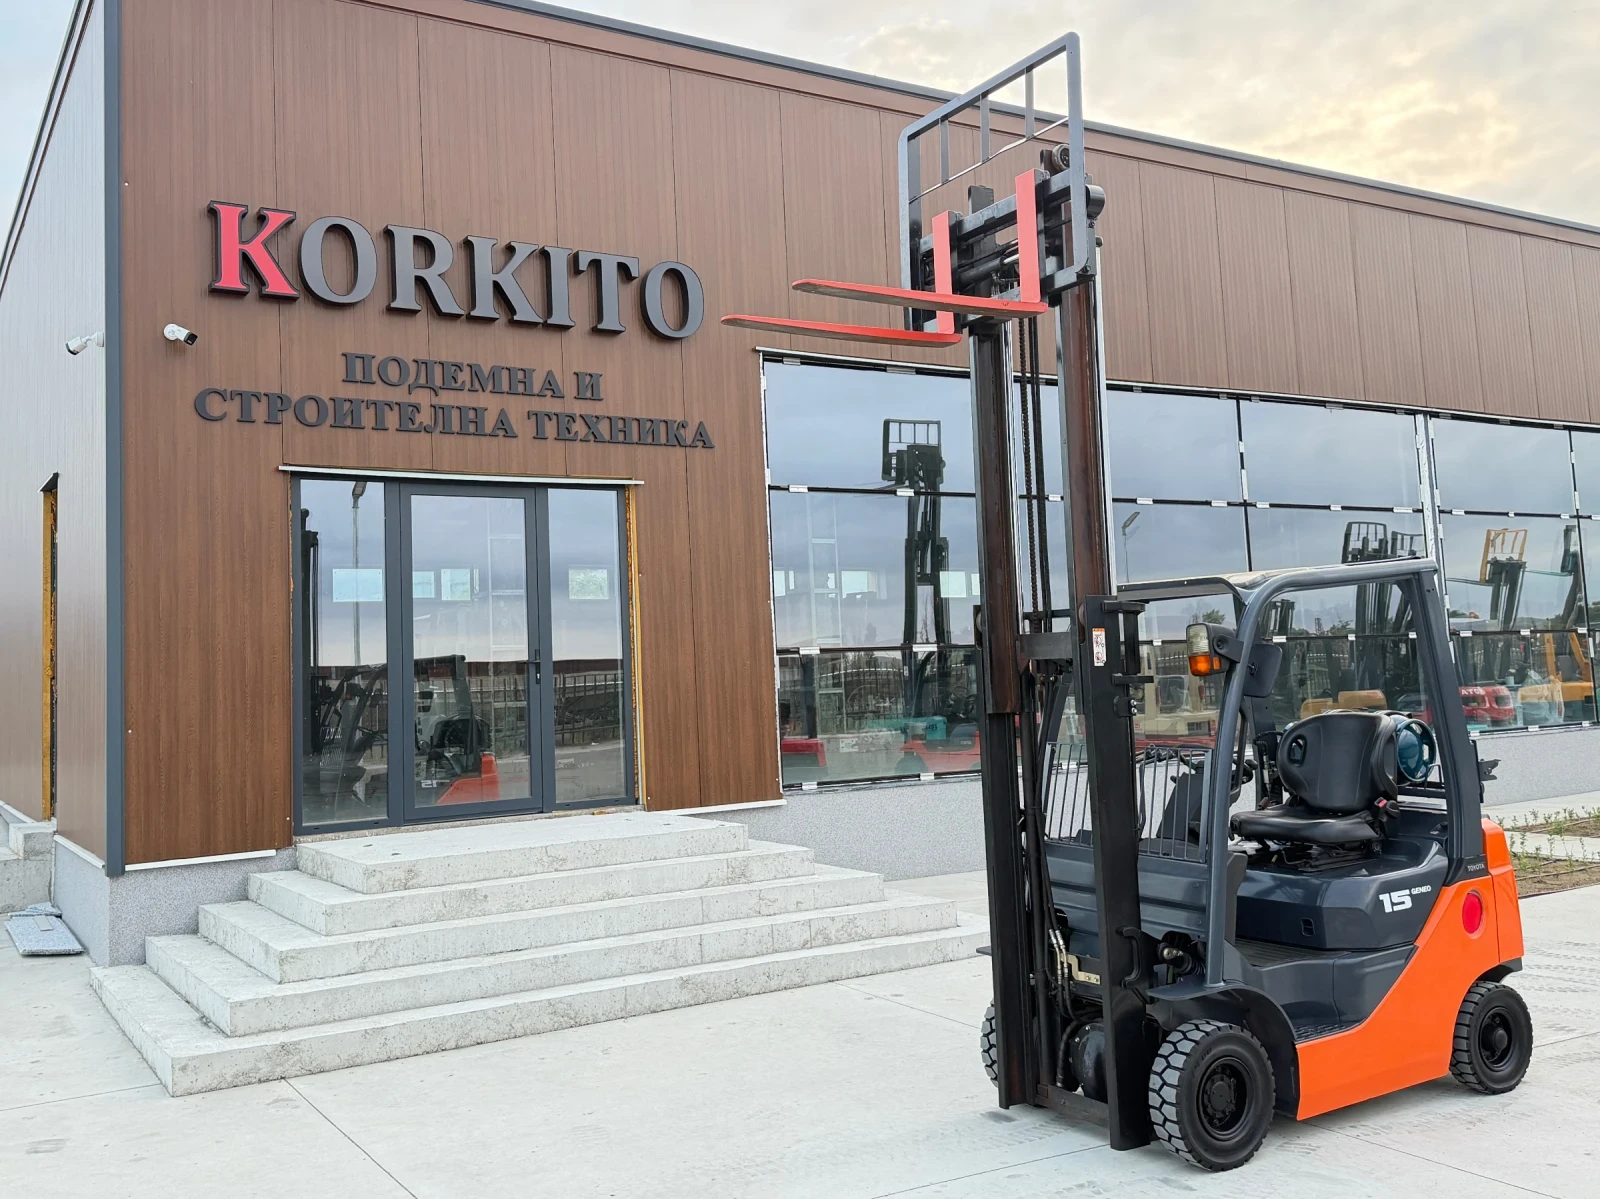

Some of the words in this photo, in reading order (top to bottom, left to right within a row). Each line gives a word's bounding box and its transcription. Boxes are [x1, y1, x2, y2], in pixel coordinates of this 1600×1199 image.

[206, 200, 704, 340] KORKITO
[342, 352, 565, 398] ПОДЕМНА
[574, 371, 603, 401] И
[194, 388, 517, 438] СТРОИТЕЛНА
[528, 410, 715, 449] ТЕХНИКА
[1467, 863, 1485, 872] TOYOTA
[1379, 889, 1412, 913] 15
[1411, 885, 1431, 895] GENEO
